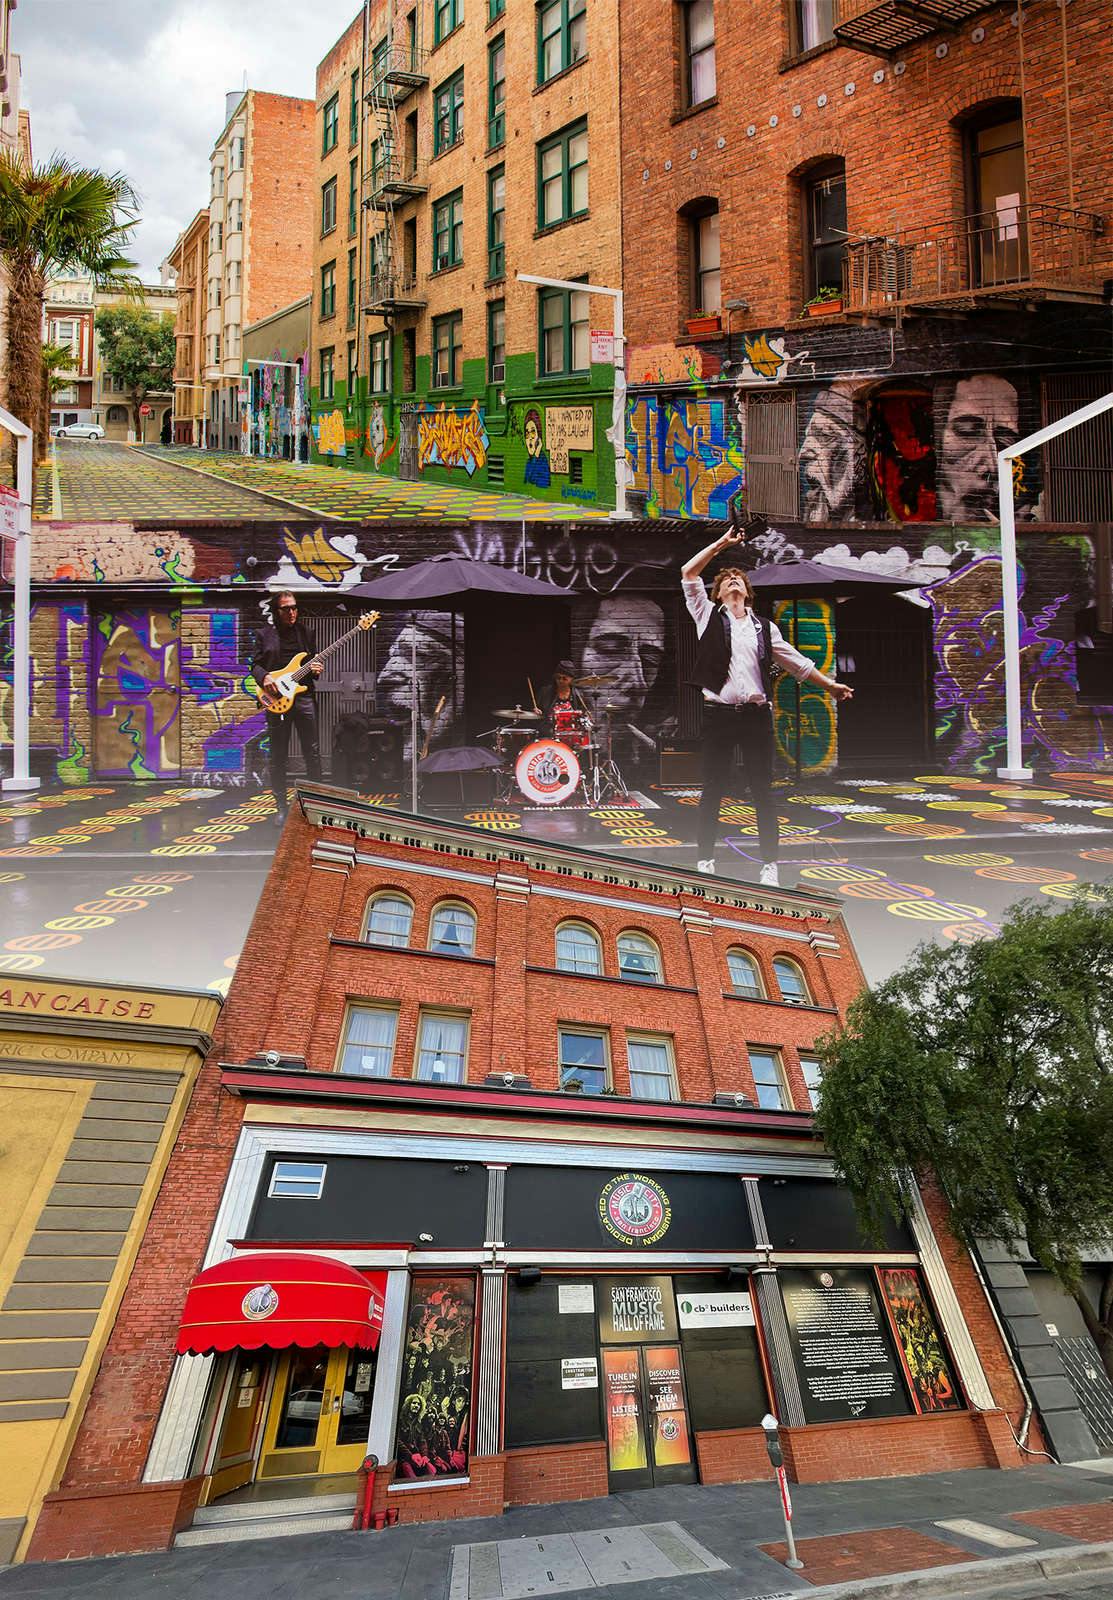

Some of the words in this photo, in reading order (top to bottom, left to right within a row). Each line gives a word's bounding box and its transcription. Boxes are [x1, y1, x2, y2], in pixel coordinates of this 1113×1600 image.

[561, 410, 583, 422] WANTED
[584, 409, 592, 421] TO
[567, 424, 590, 438] LAUGH
[41, 1047, 136, 1065] COMPANY
[611, 1173, 630, 1185] THE
[602, 1183, 613, 1196] TO
[633, 1173, 670, 1206] WORKING
[611, 1184, 632, 1209] MUSIC
[644, 1189, 660, 1208] CITY
[600, 1198, 633, 1245] DEDICATED
[614, 1216, 628, 1229] san
[628, 1216, 660, 1234] francisco
[643, 1207, 672, 1246] MUSICIAN
[611, 1289, 625, 1302] SAN
[626, 1289, 662, 1302] FRANCISCO
[613, 1301, 664, 1315] MUSIC
[710, 1303, 750, 1312] builders
[613, 1316, 632, 1331] HALL
[634, 1316, 645, 1331] OF
[645, 1315, 665, 1330] FAME
[608, 1373, 629, 1381] TUNE
[629, 1372, 637, 1380] IN
[649, 1369, 680, 1377] DISCOVER
[660, 1386, 673, 1394] SEE
[655, 1394, 678, 1402] THEM
[612, 1404, 638, 1413] LISTEN
